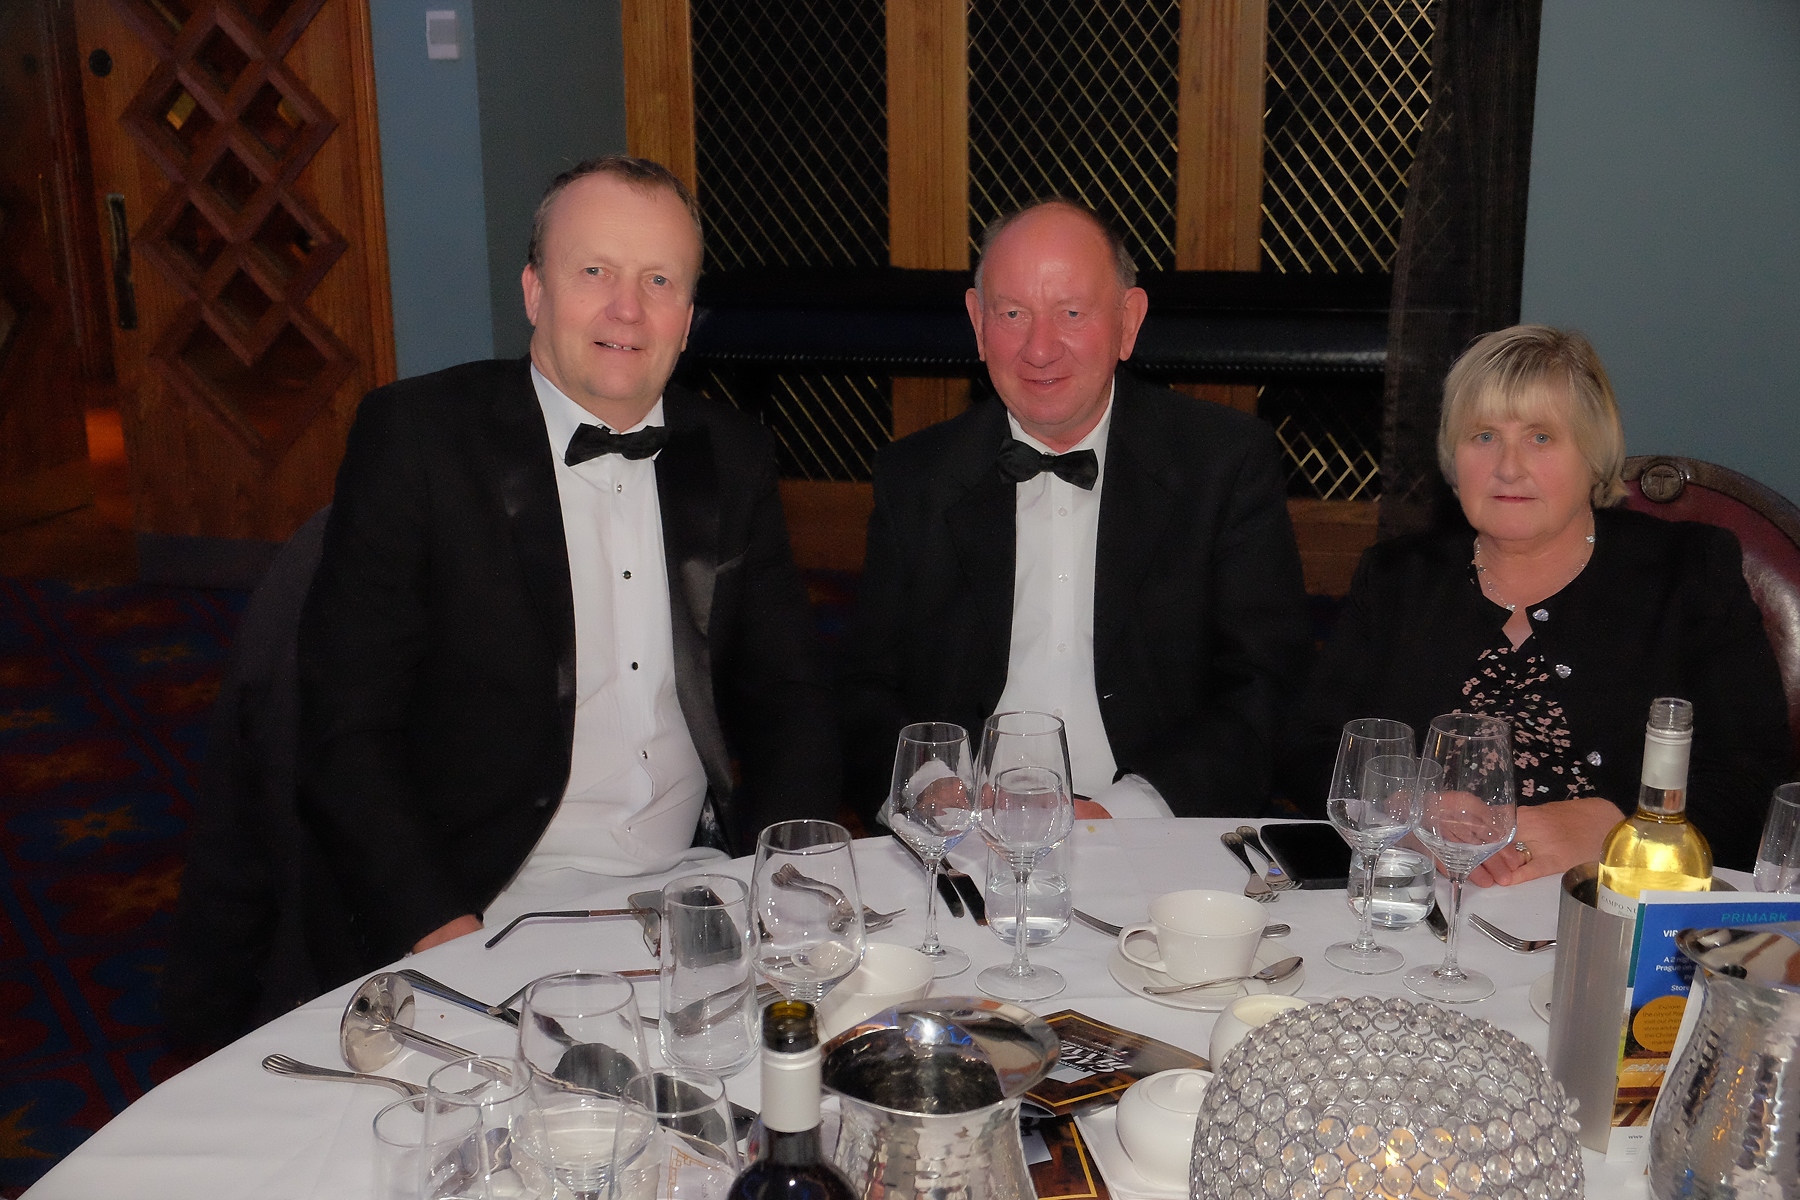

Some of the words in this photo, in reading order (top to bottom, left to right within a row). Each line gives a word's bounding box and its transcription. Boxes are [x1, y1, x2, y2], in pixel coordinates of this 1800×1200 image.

[1601, 895, 1624, 910] CAMPO
[1721, 912, 1788, 923] PRIMARK
[1655, 964, 1681, 973] Prague
